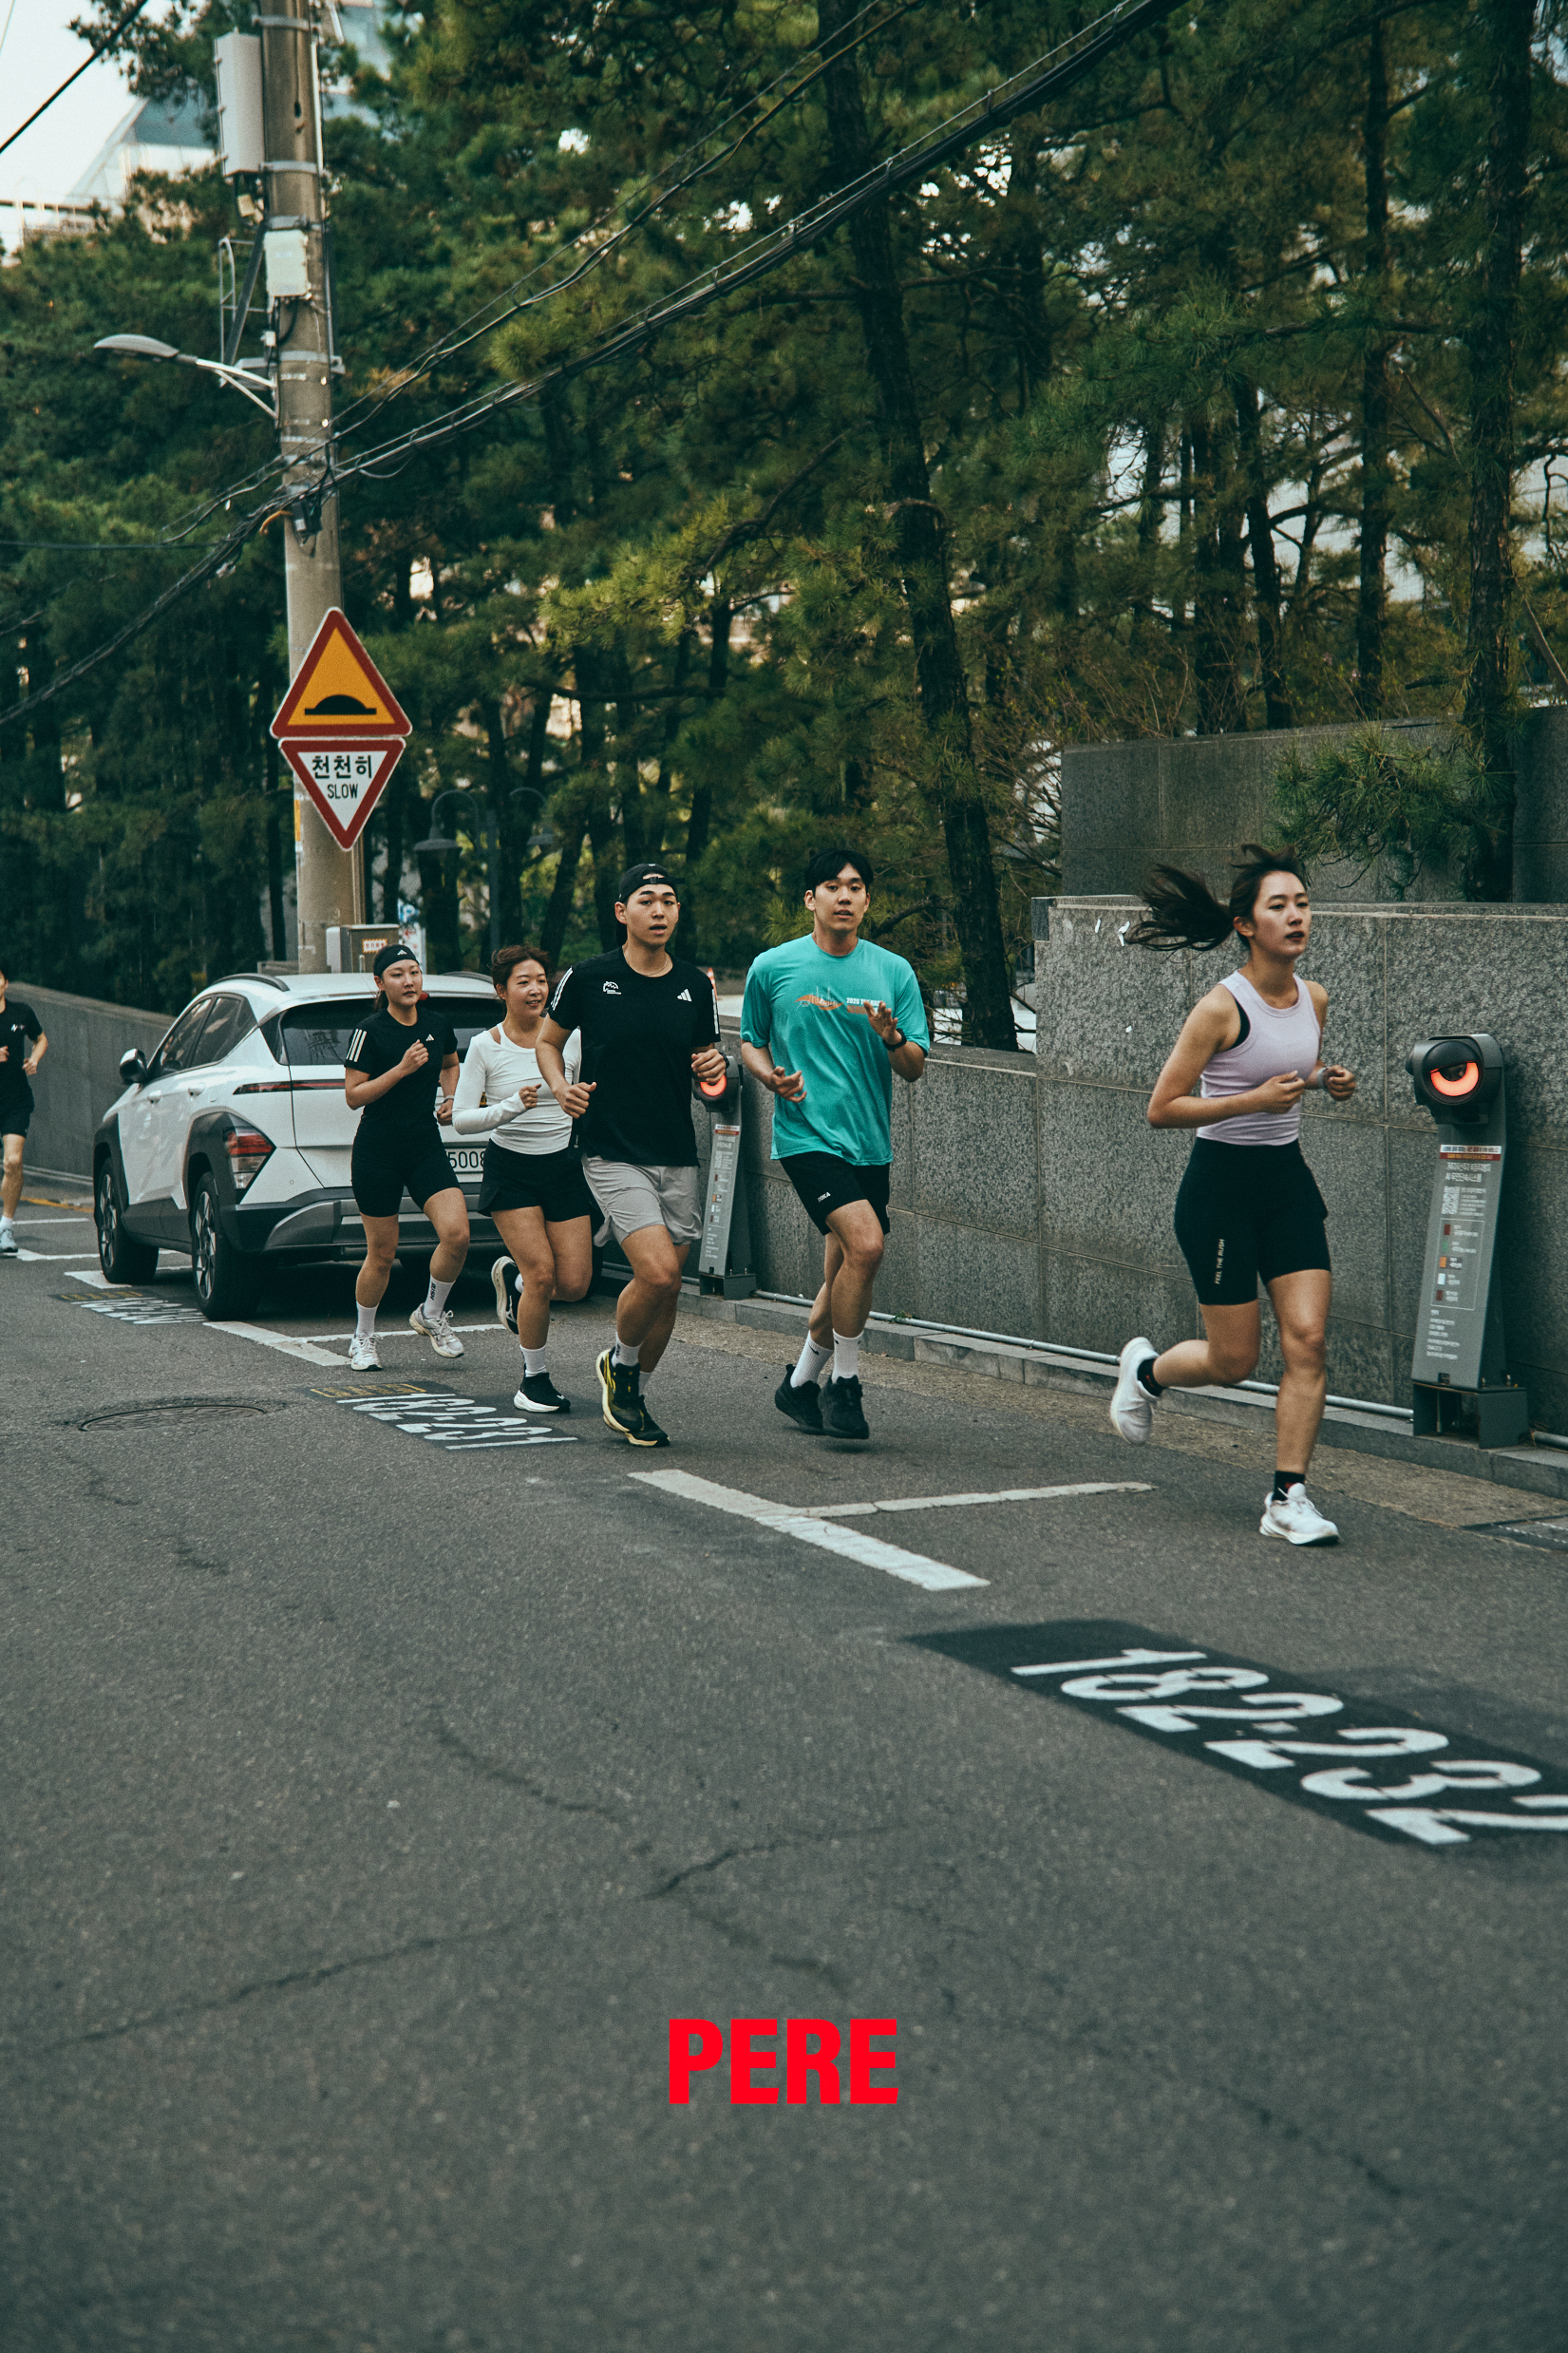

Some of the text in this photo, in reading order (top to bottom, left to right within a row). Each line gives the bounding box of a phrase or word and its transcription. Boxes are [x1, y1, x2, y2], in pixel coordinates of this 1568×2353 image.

[312, 754, 372, 780] 천천히
[327, 783, 359, 799] SLOW
[1214, 1239, 1225, 1284] FEEL THE RUSH
[335, 1393, 579, 1451] 182-231
